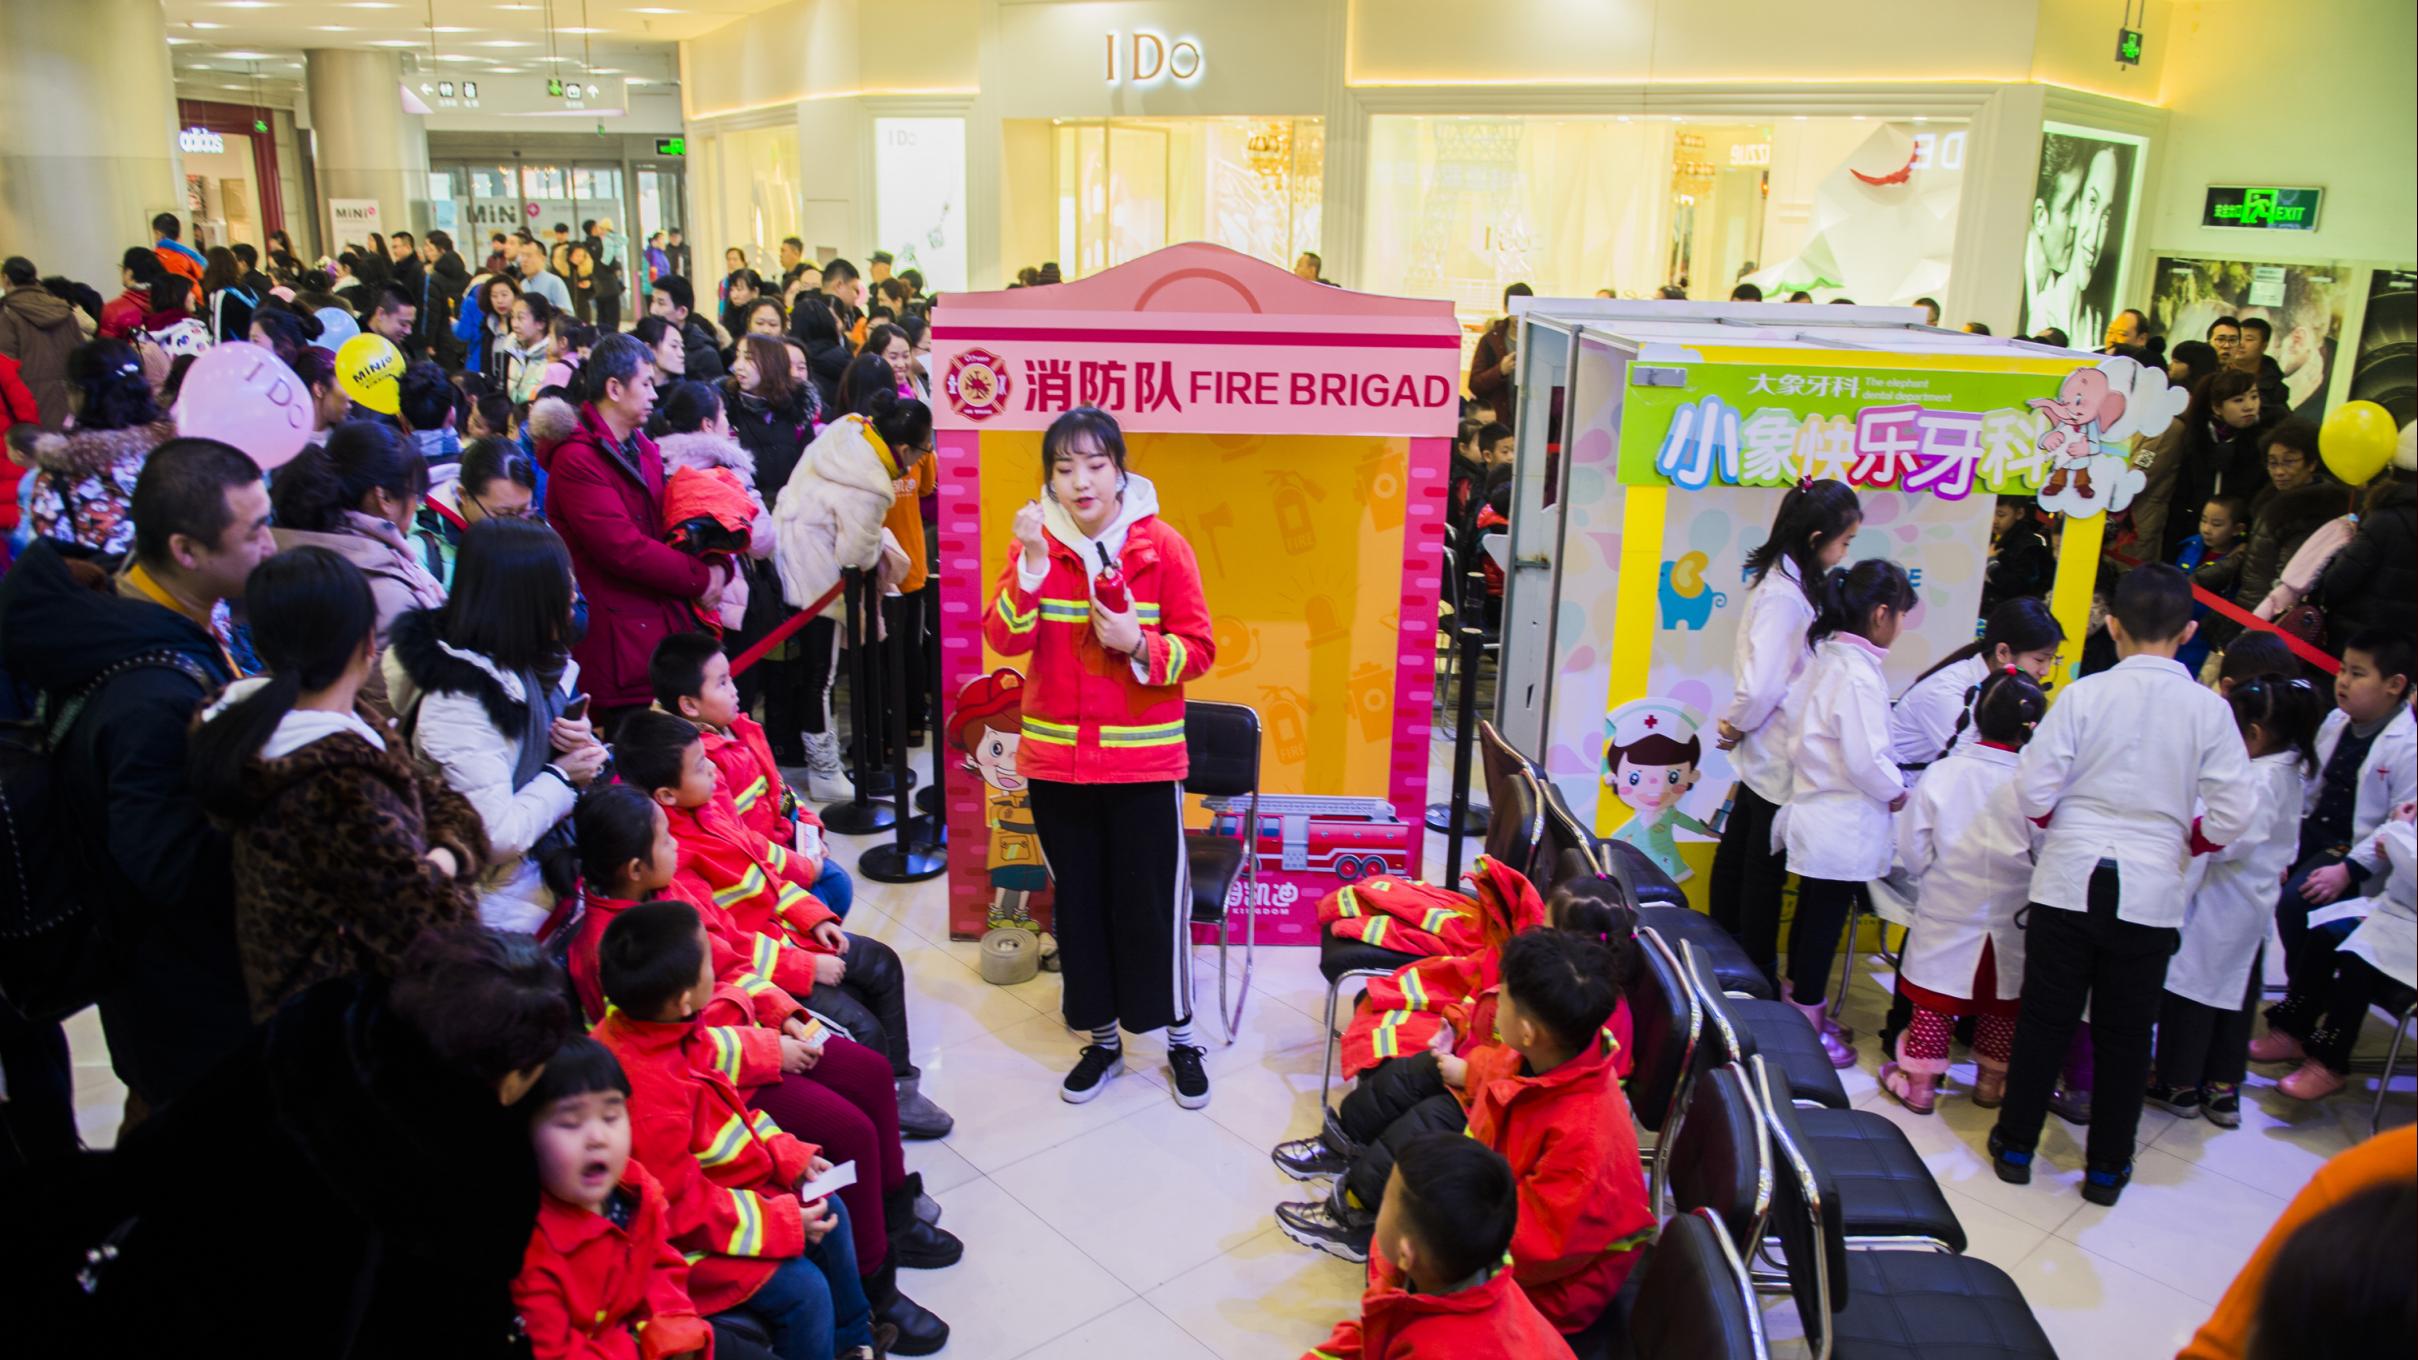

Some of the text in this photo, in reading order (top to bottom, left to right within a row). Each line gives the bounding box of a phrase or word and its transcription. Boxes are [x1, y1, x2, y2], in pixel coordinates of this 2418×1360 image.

[179, 127, 224, 154] adidas
[2274, 206, 2306, 221] EXIT
[1024, 358, 1182, 413] 消防队
[1189, 370, 1451, 408] FIRE BRIGAD
[1746, 372, 1861, 399] 大象牙科
[1657, 394, 2050, 500] 小象快乐牙科
